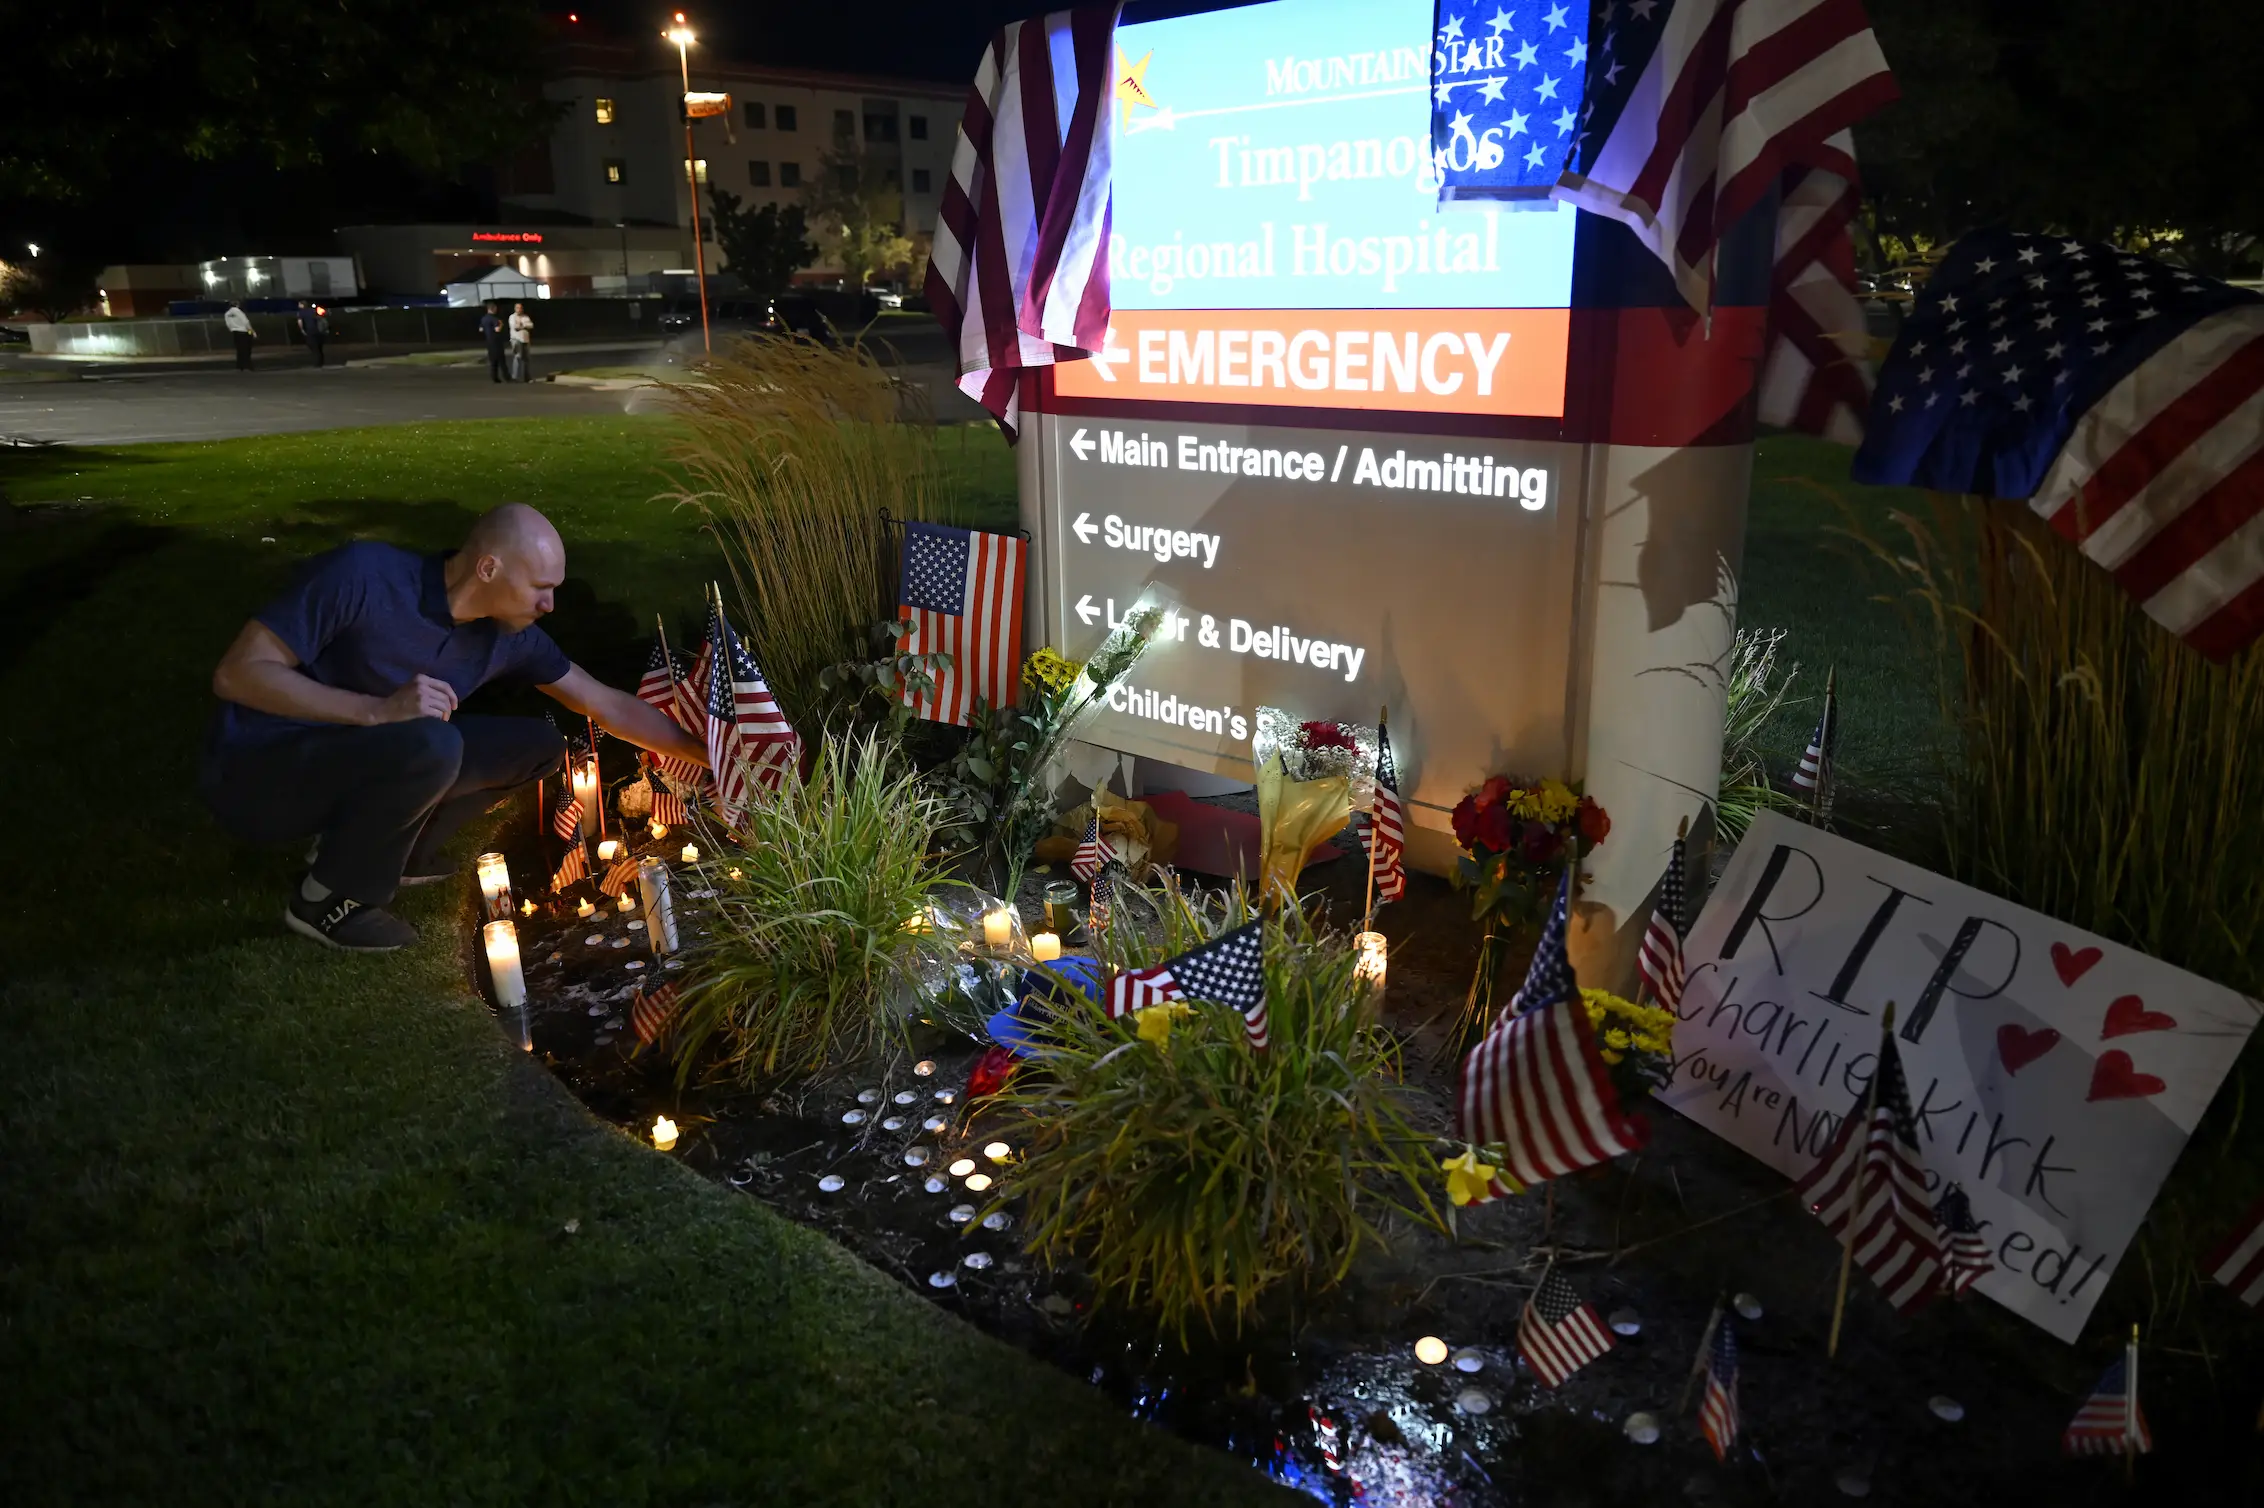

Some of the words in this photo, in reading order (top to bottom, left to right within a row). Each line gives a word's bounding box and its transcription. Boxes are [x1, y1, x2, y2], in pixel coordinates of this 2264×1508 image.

[1208, 127, 1505, 202] Timpanogos
[472, 232, 520, 241] Ambulance
[522, 232, 543, 243] Only
[1110, 221, 1276, 296] Regional
[1290, 211, 1501, 293] Hospital
[1137, 329, 1511, 396] EMERGENCY
[1099, 429, 1169, 469] Main
[1178, 435, 1325, 482] Entrance
[1330, 444, 1348, 482] /
[1352, 447, 1548, 511] Admitting
[1103, 513, 1221, 569] Surgery
[1198, 614, 1221, 649] &
[1229, 617, 1366, 682] Delivery
[1107, 680, 1248, 741] Children's
[1676, 962, 1879, 1099] Charlie
[1658, 1039, 1731, 1092] You
[1718, 1071, 1781, 1119] Are
